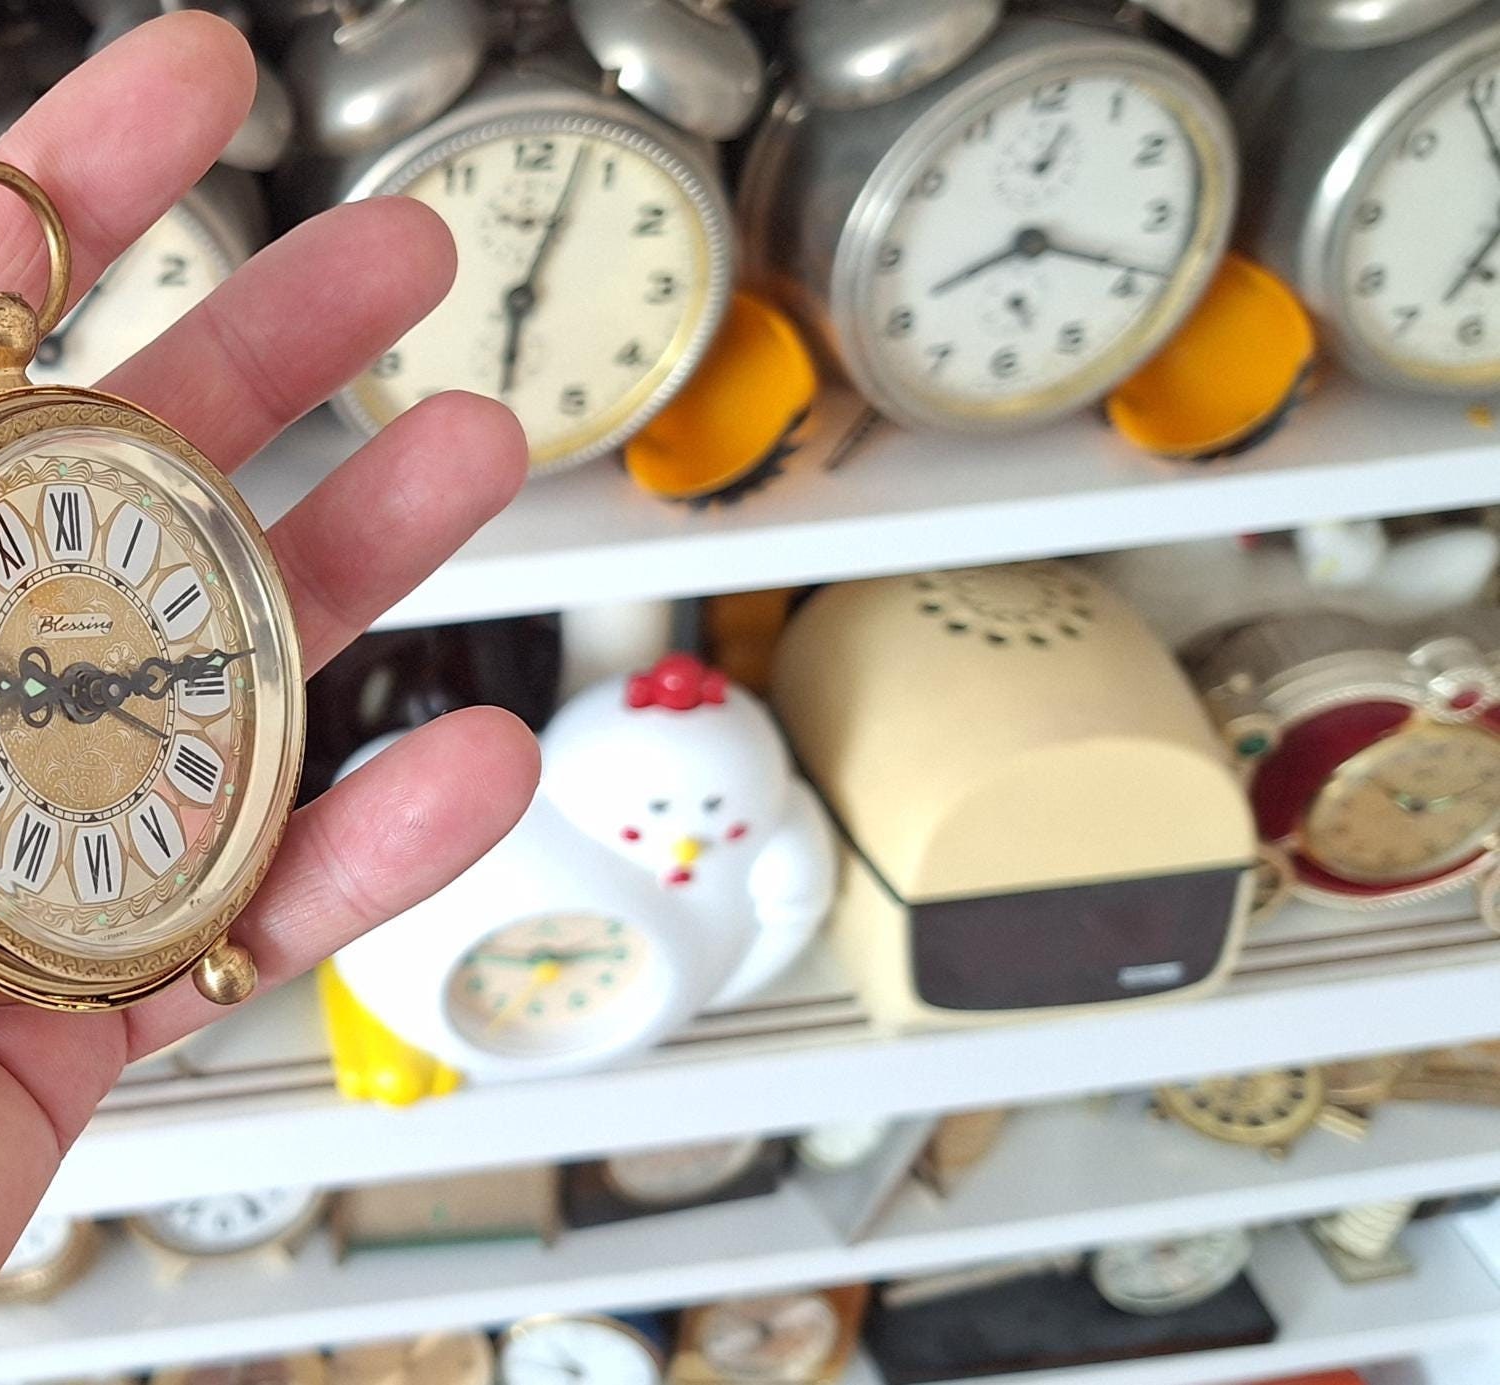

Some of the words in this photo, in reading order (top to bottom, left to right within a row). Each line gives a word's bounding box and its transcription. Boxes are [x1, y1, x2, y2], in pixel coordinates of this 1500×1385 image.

[513, 139, 557, 173] 12
[1134, 135, 1167, 167] 2
[444, 162, 476, 195] 11
[602, 160, 618, 191] 1
[632, 204, 667, 237] 2
[1143, 200, 1172, 233] 3
[157, 256, 191, 287] 2
[645, 270, 677, 305] 3
[615, 341, 644, 369] 4
[49, 491, 82, 552] XII
[122, 517, 144, 569] I
[163, 583, 201, 623] II
[37, 614, 114, 635] Blessing
[173, 743, 218, 793] IIII
[12, 812, 51, 883] VII
[140, 805, 171, 859] V
[83, 833, 113, 895] VI
